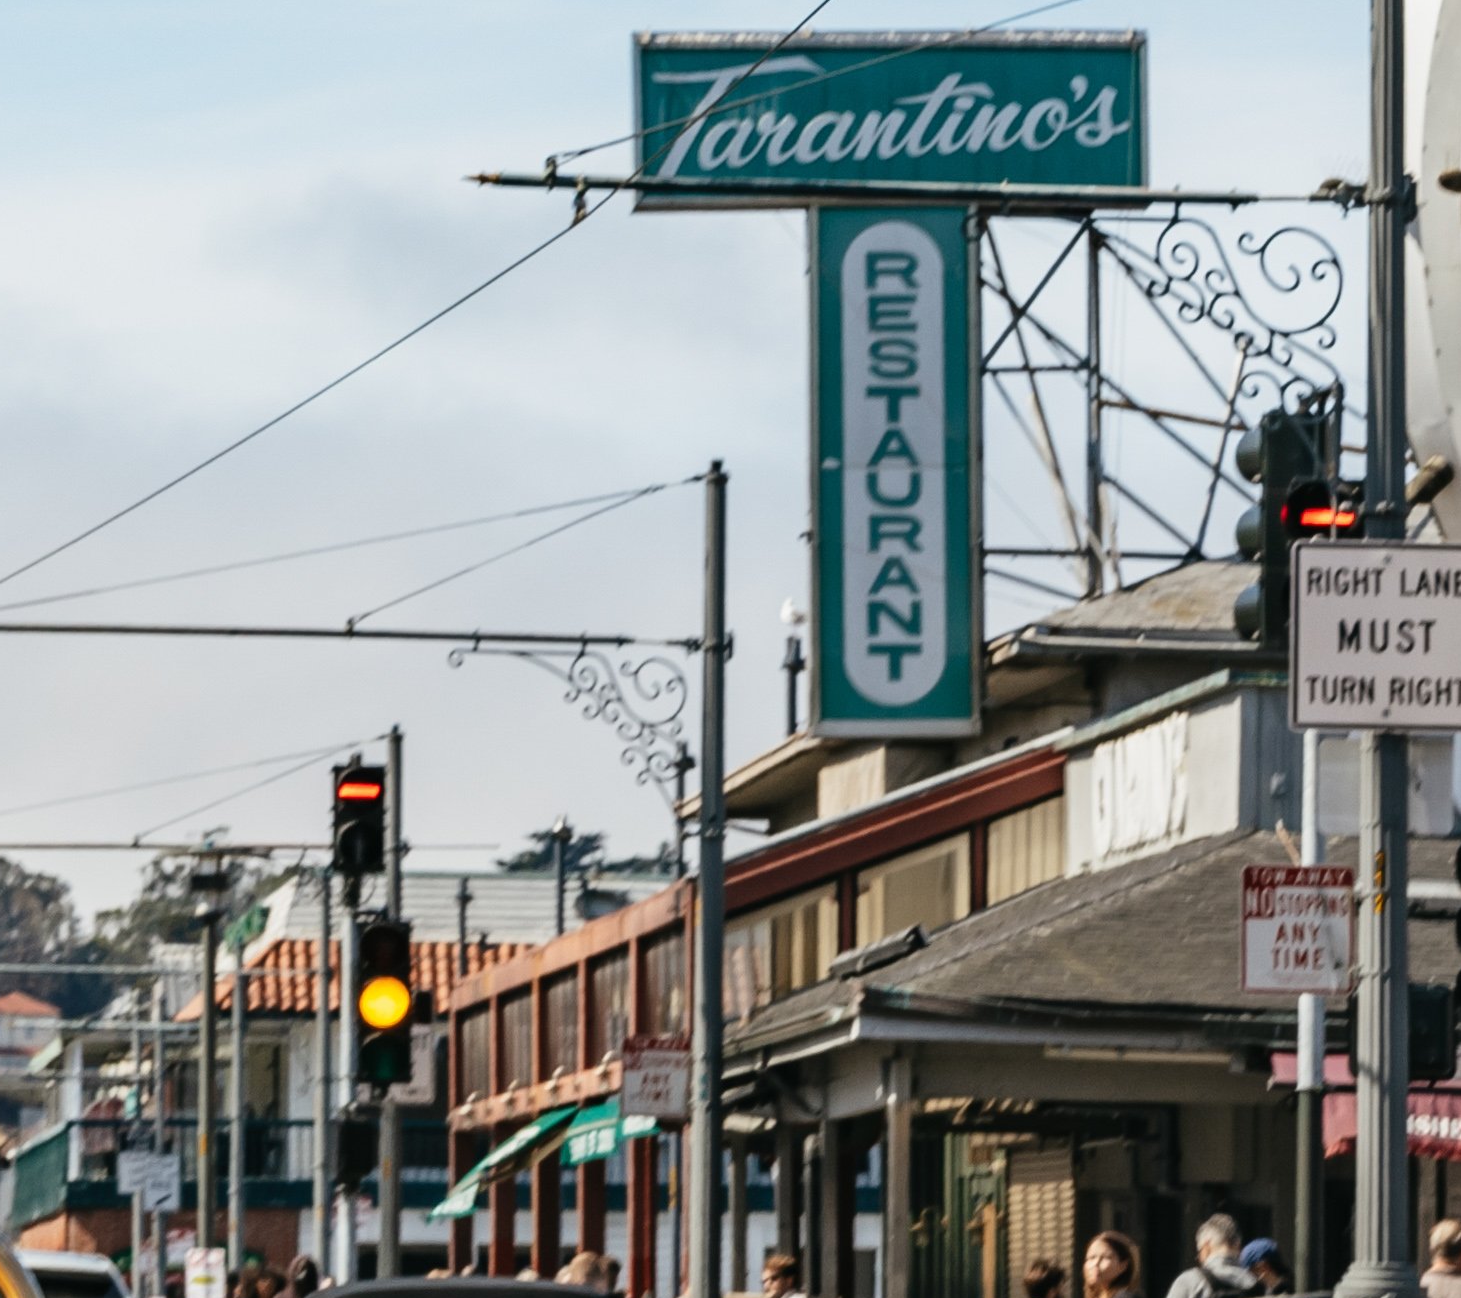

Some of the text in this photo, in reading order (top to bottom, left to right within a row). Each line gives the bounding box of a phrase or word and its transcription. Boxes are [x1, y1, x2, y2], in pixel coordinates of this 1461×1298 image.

[651, 55, 1133, 180] Tarantino's
[864, 251, 923, 682] RESTAURANT
[1306, 566, 1384, 597] RIGHT
[1337, 618, 1437, 655] MUST
[1305, 675, 1375, 705] TURN
[1249, 868, 1348, 886] TOW-AWAY
[1245, 888, 1350, 918] NO STOPPING
[1274, 921, 1322, 944] ANY
[1271, 946, 1326, 971] TIME
